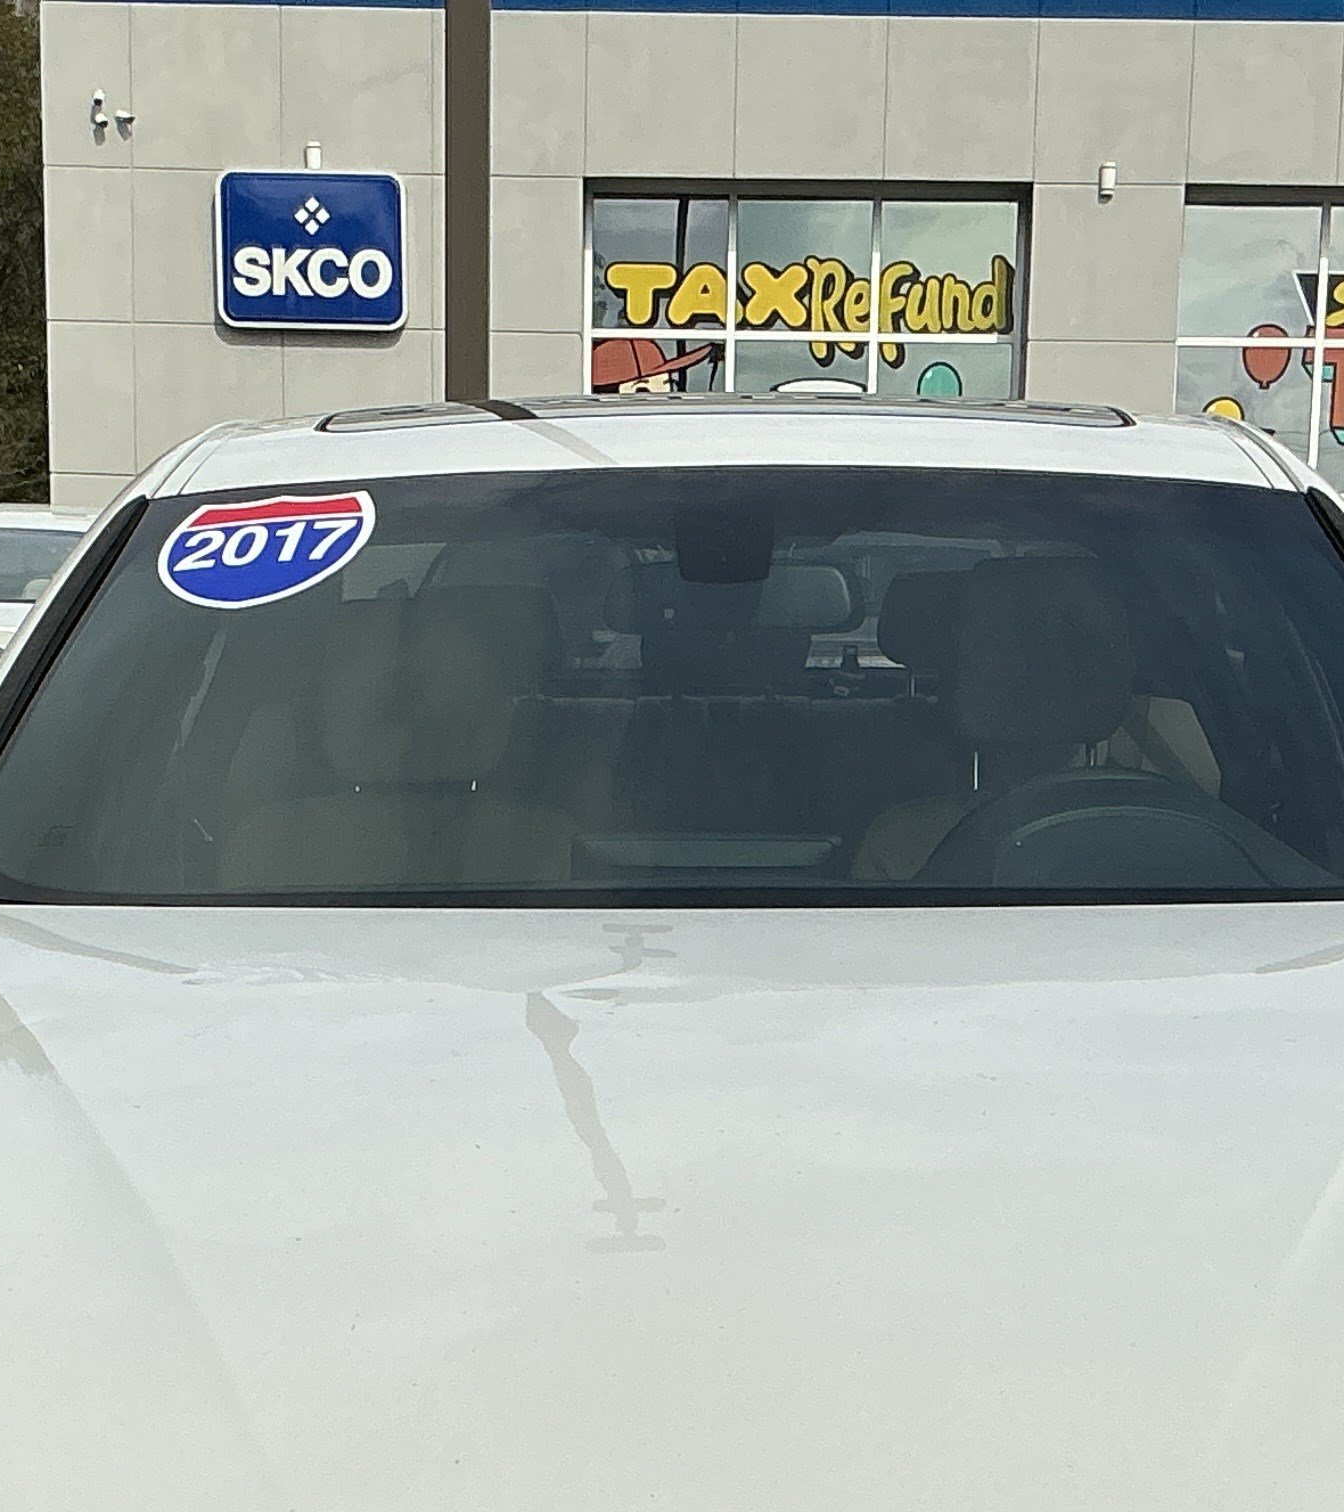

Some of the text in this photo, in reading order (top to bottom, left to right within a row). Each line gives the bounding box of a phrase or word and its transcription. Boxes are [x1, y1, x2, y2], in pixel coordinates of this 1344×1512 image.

[233, 246, 392, 299] SKCO
[606, 261, 809, 328] TAX
[173, 519, 358, 573] 2017
